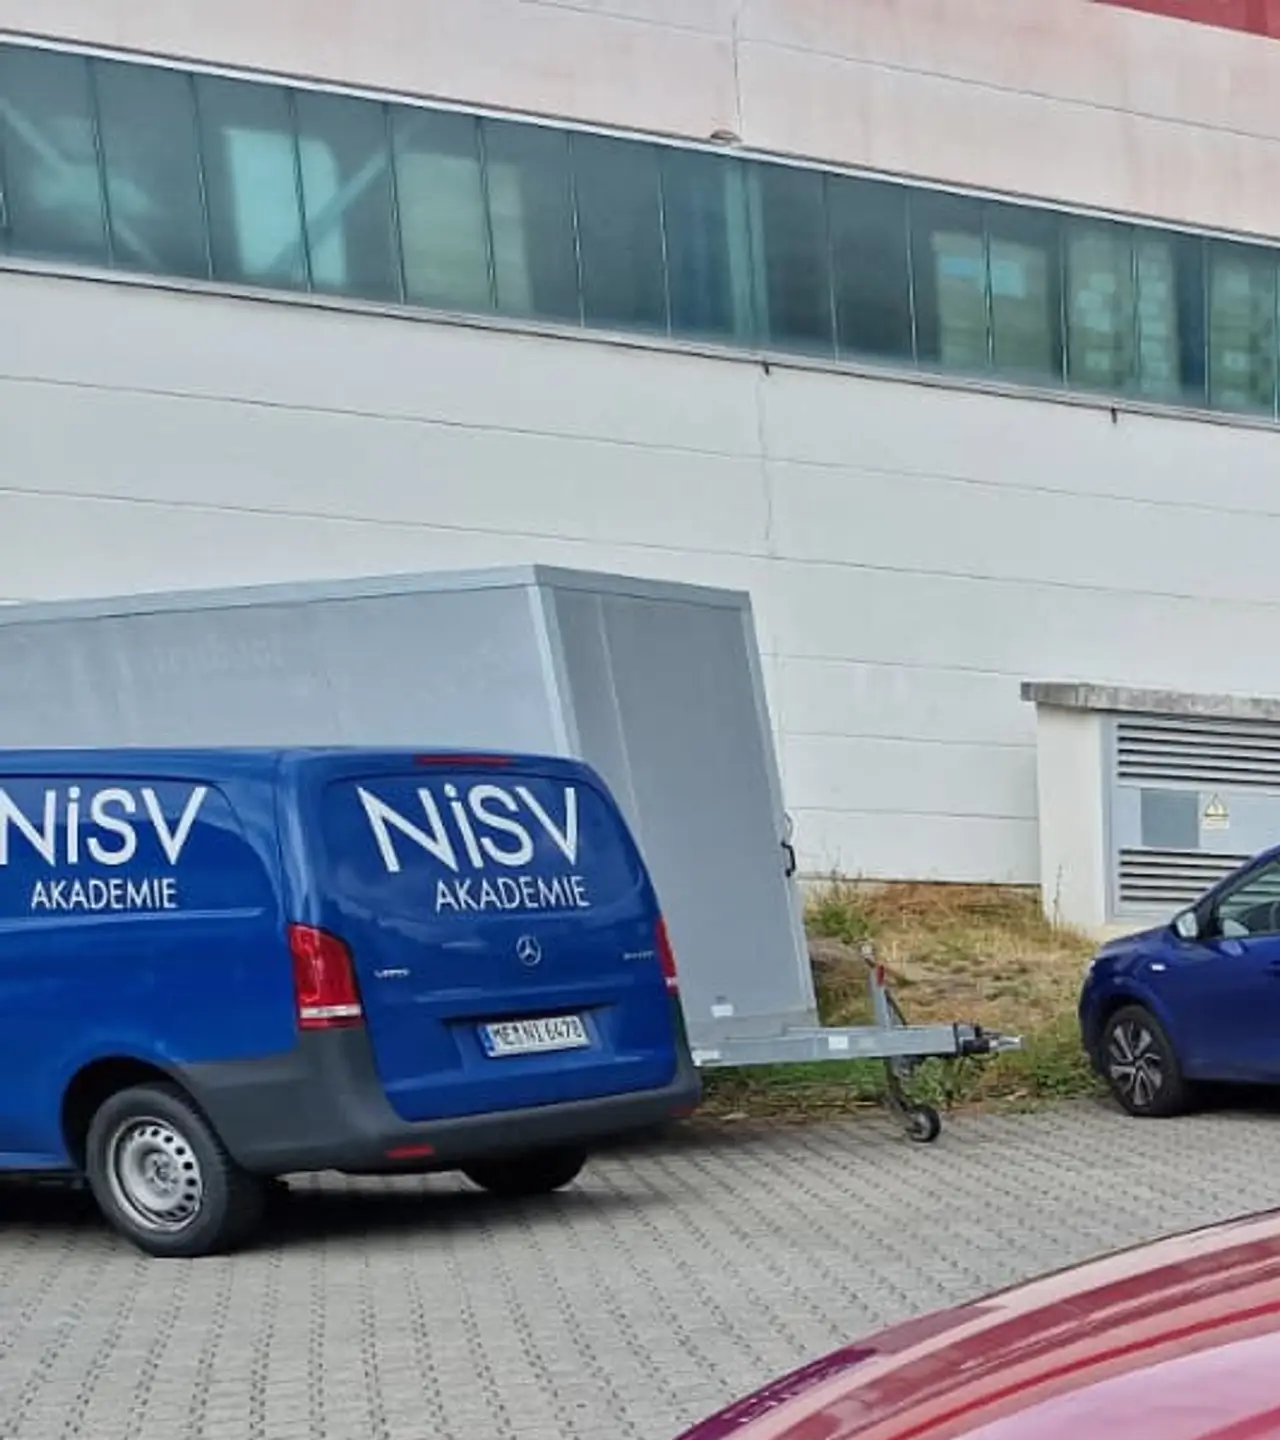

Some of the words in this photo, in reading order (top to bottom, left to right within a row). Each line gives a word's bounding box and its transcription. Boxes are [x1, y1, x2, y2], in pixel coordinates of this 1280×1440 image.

[0, 785, 207, 868] NiSV
[355, 783, 578, 873] NiSV
[31, 877, 179, 910] AKADEMIE
[435, 875, 592, 915] AKADEMIE
